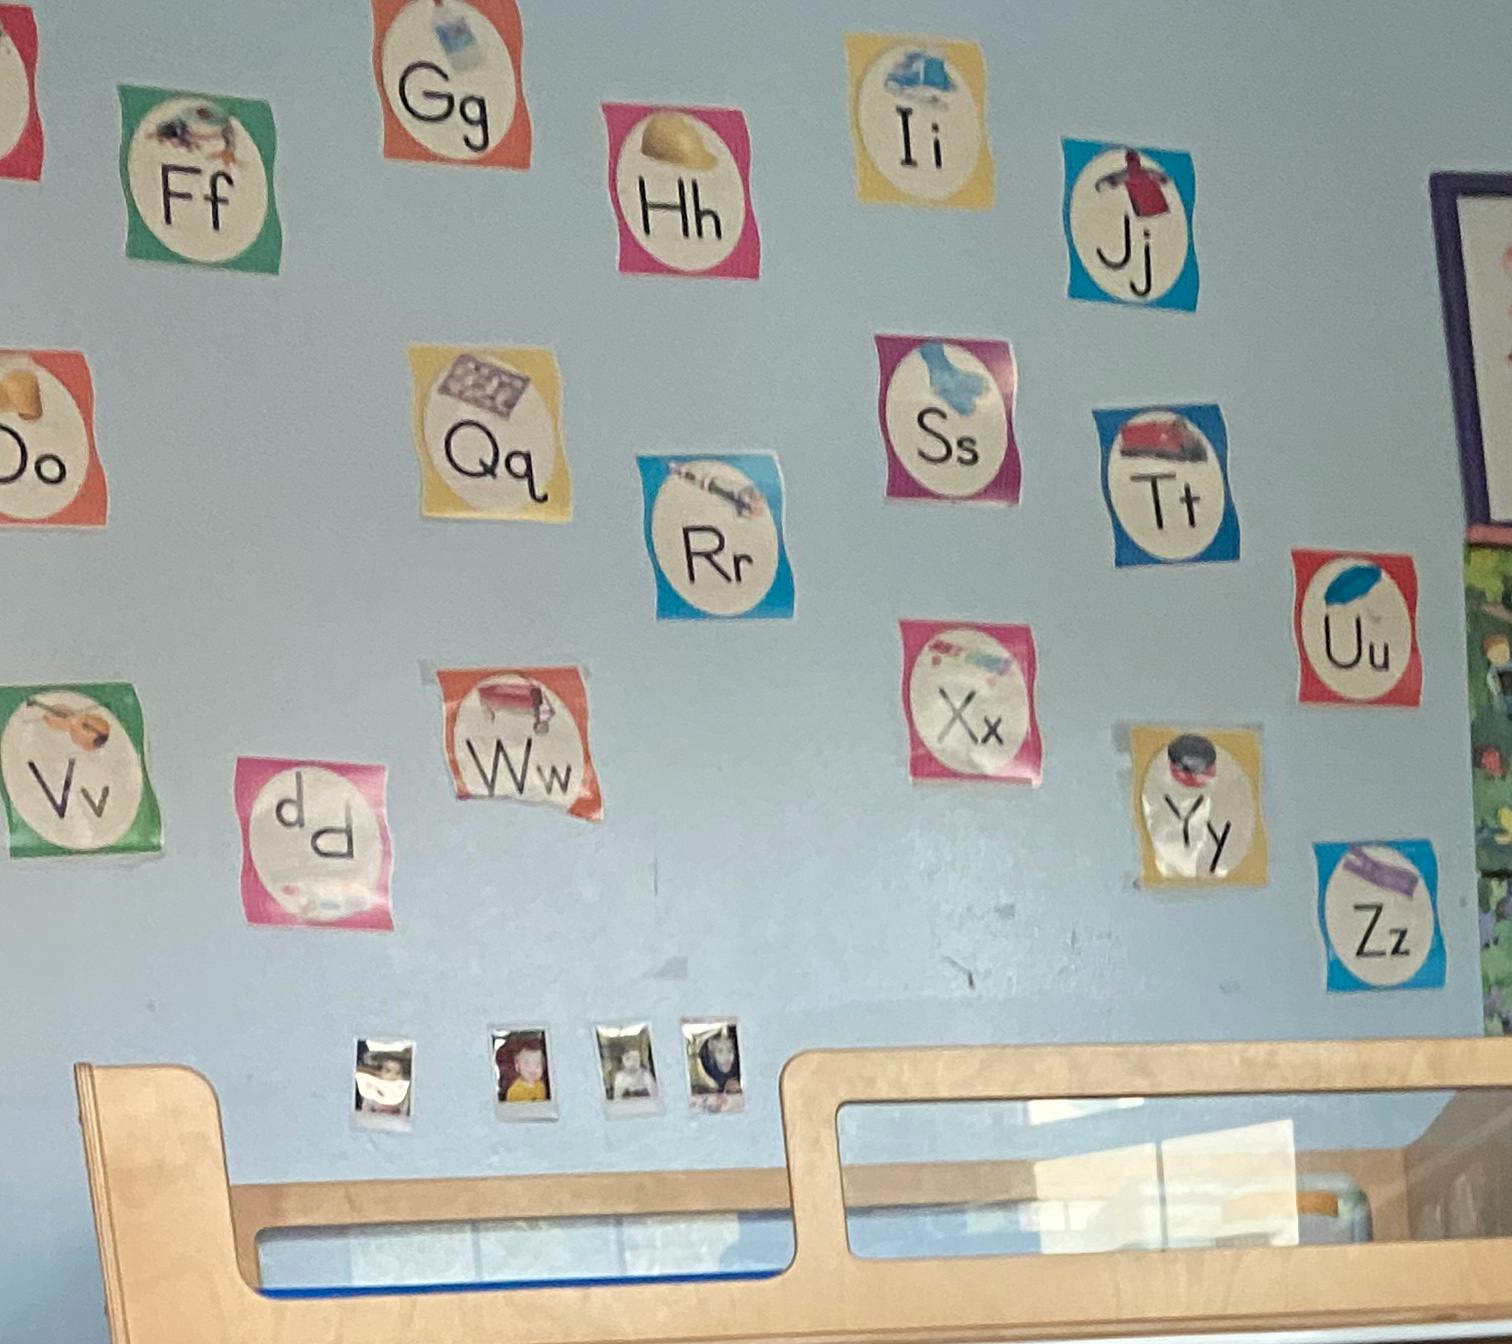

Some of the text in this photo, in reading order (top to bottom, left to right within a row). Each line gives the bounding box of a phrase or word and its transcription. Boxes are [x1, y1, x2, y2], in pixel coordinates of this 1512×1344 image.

[399, 61, 489, 152] Gg
[897, 108, 941, 168] Ii
[162, 164, 233, 231] Ff
[639, 176, 721, 239] Hh
[1097, 214, 1152, 297] Jj
[445, 420, 548, 503] Qq
[917, 407, 979, 466] Ss
[1132, 475, 1200, 530] Tt
[683, 526, 752, 584] Rr
[1325, 615, 1389, 670] Uu
[939, 688, 1003, 745] Xx
[28, 759, 109, 819] Vv
[467, 737, 572, 797] Ww
[1165, 795, 1231, 873] Yy
[1354, 904, 1409, 957] Zz
